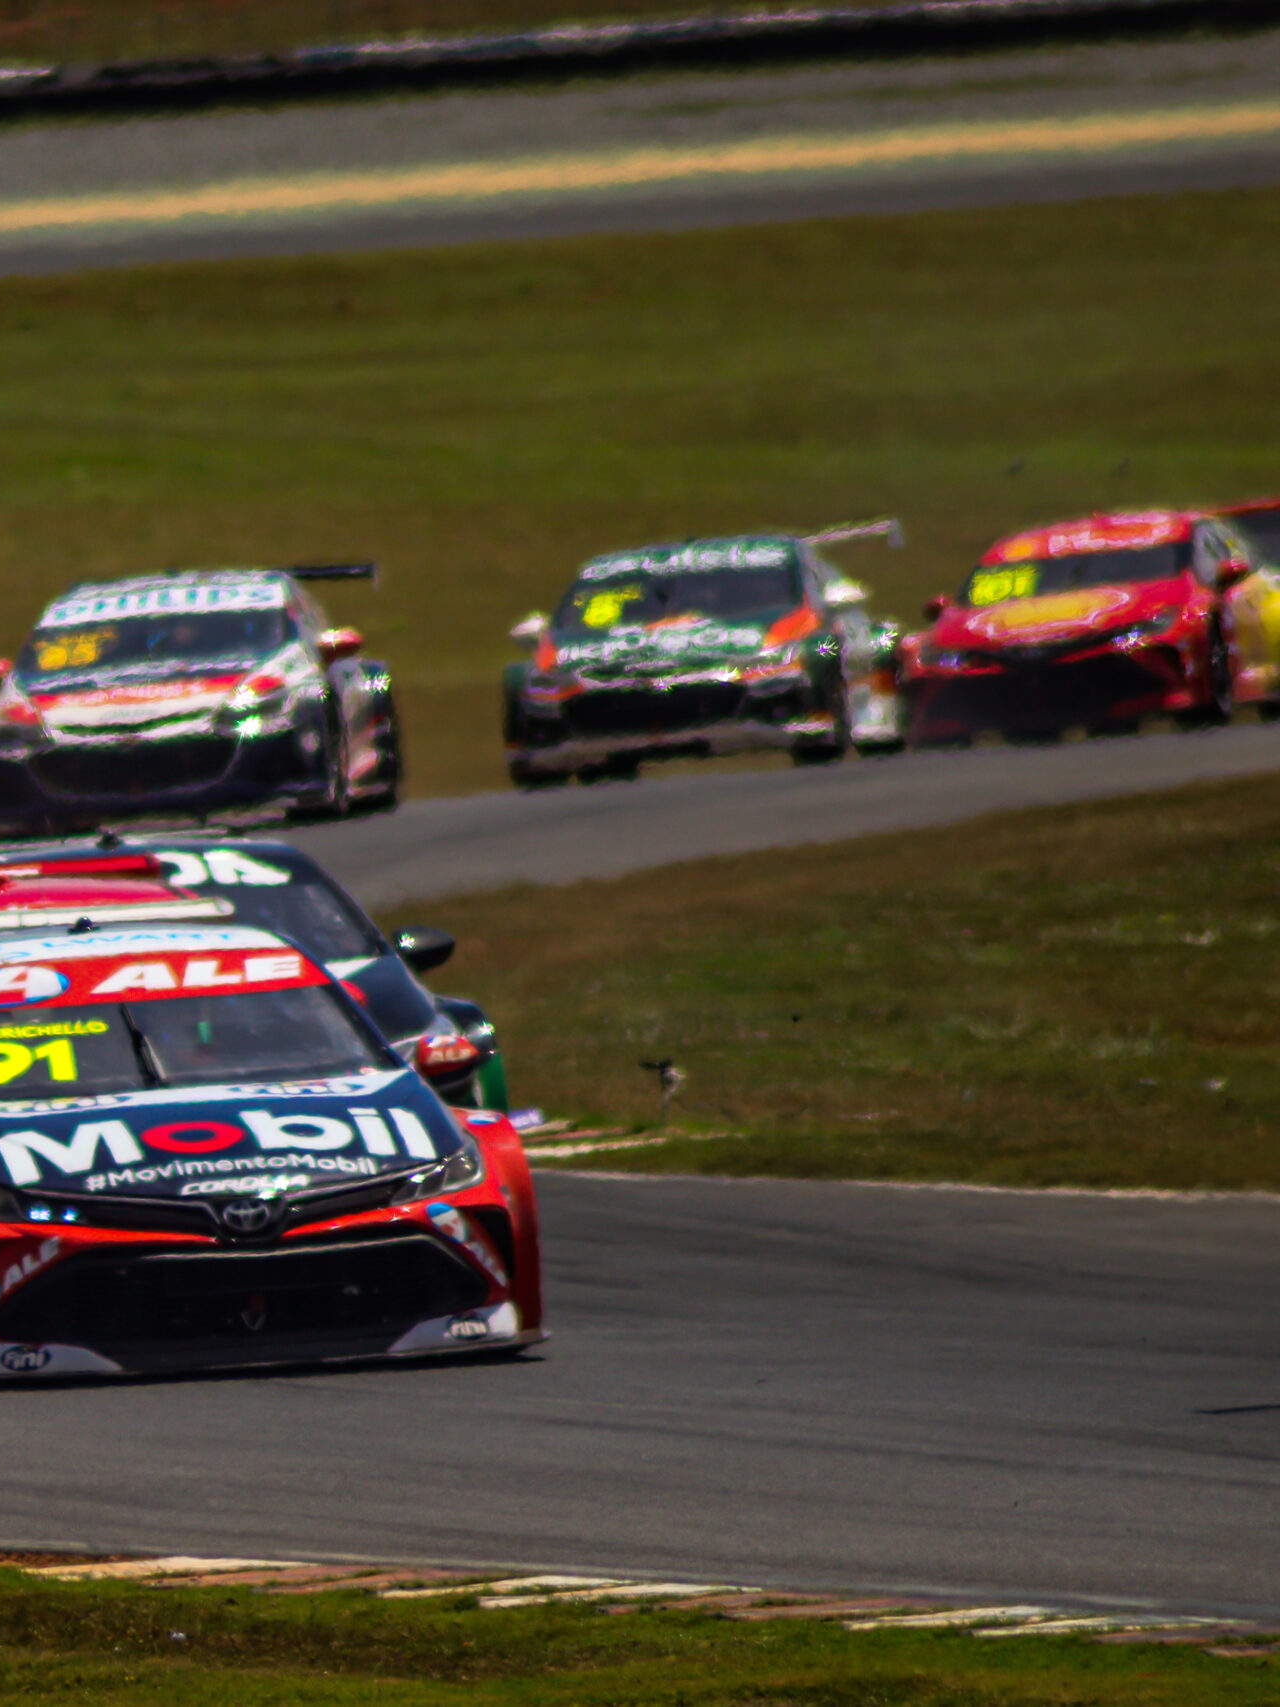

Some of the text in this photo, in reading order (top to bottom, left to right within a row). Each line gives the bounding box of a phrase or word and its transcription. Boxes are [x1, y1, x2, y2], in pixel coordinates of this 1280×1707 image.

[54, 588, 276, 622] PHILIPS
[91, 956, 302, 994] ALE
[86, 1151, 378, 1194] #MovimentoMobil
[3, 1235, 60, 1294] ALE
